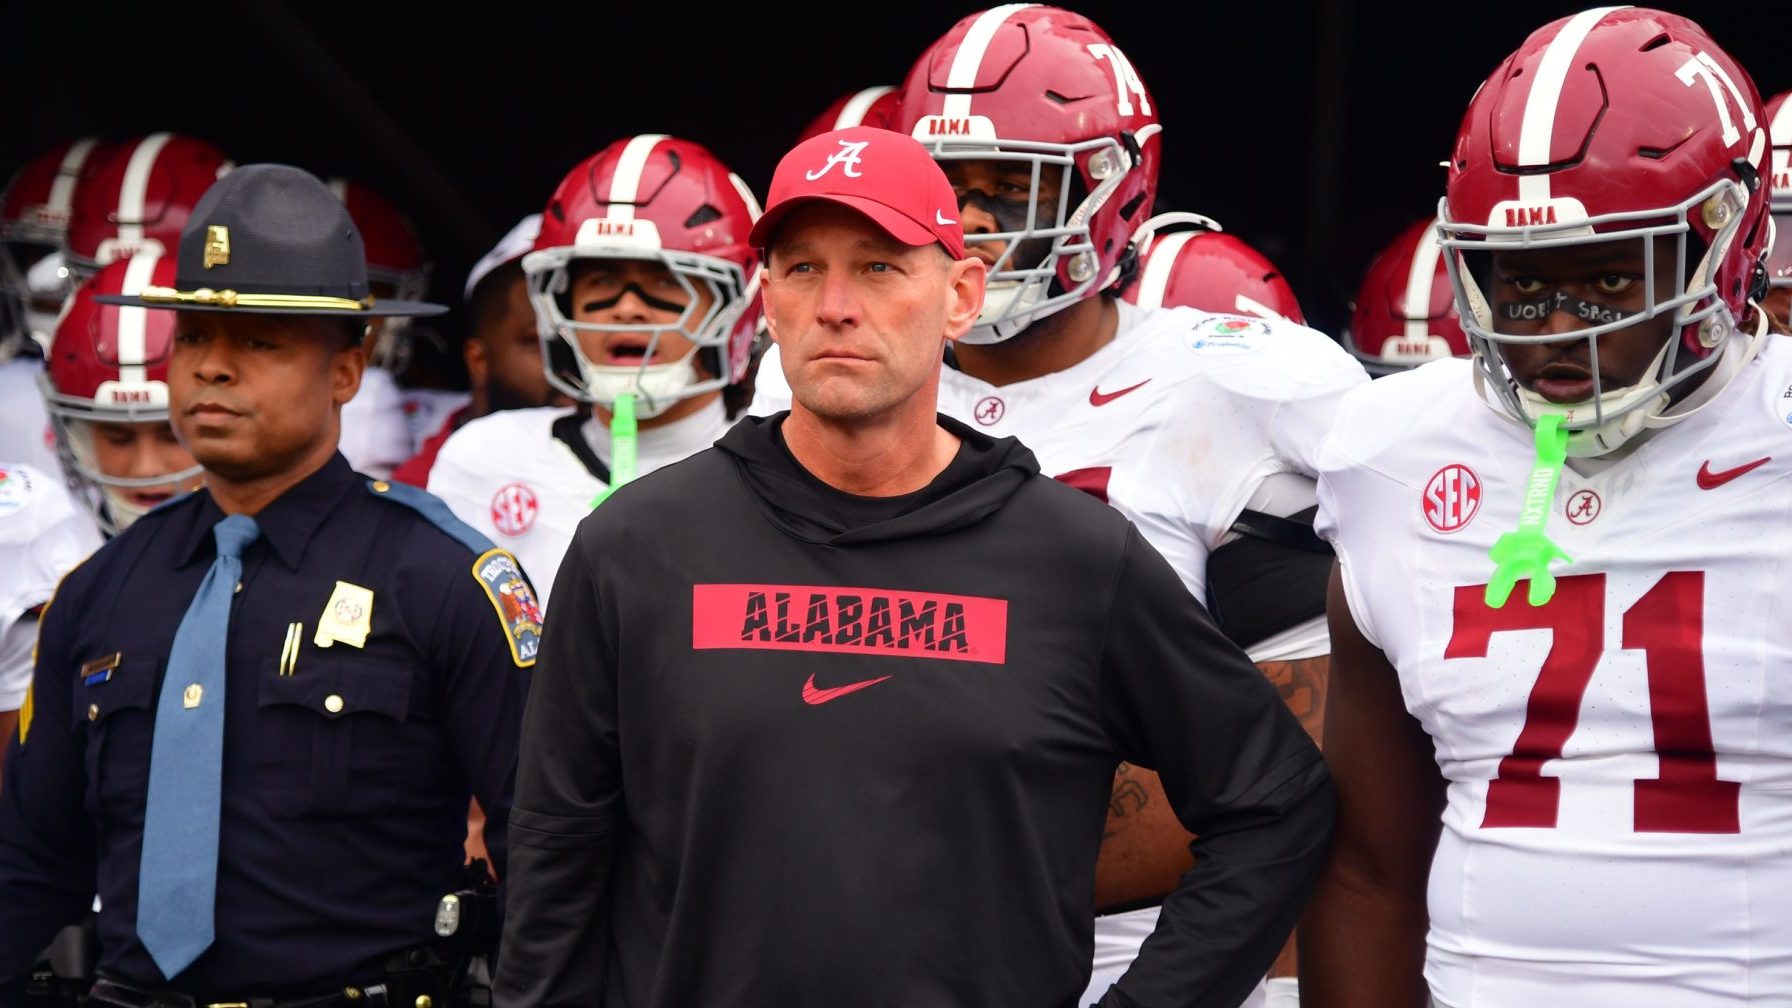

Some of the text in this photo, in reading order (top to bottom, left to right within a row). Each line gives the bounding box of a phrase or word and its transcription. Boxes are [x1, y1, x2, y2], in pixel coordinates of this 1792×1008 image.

[1085, 43, 1152, 116] 74
[1674, 50, 1757, 149] 71
[929, 118, 970, 135] BAMA
[805, 139, 870, 181] A
[1505, 206, 1557, 227] BAMA
[493, 487, 538, 531] SEC
[1426, 467, 1478, 528] SEC
[1521, 467, 1554, 527] NXTRND
[741, 591, 969, 654] ALABAMA
[1443, 570, 1743, 835] 71
